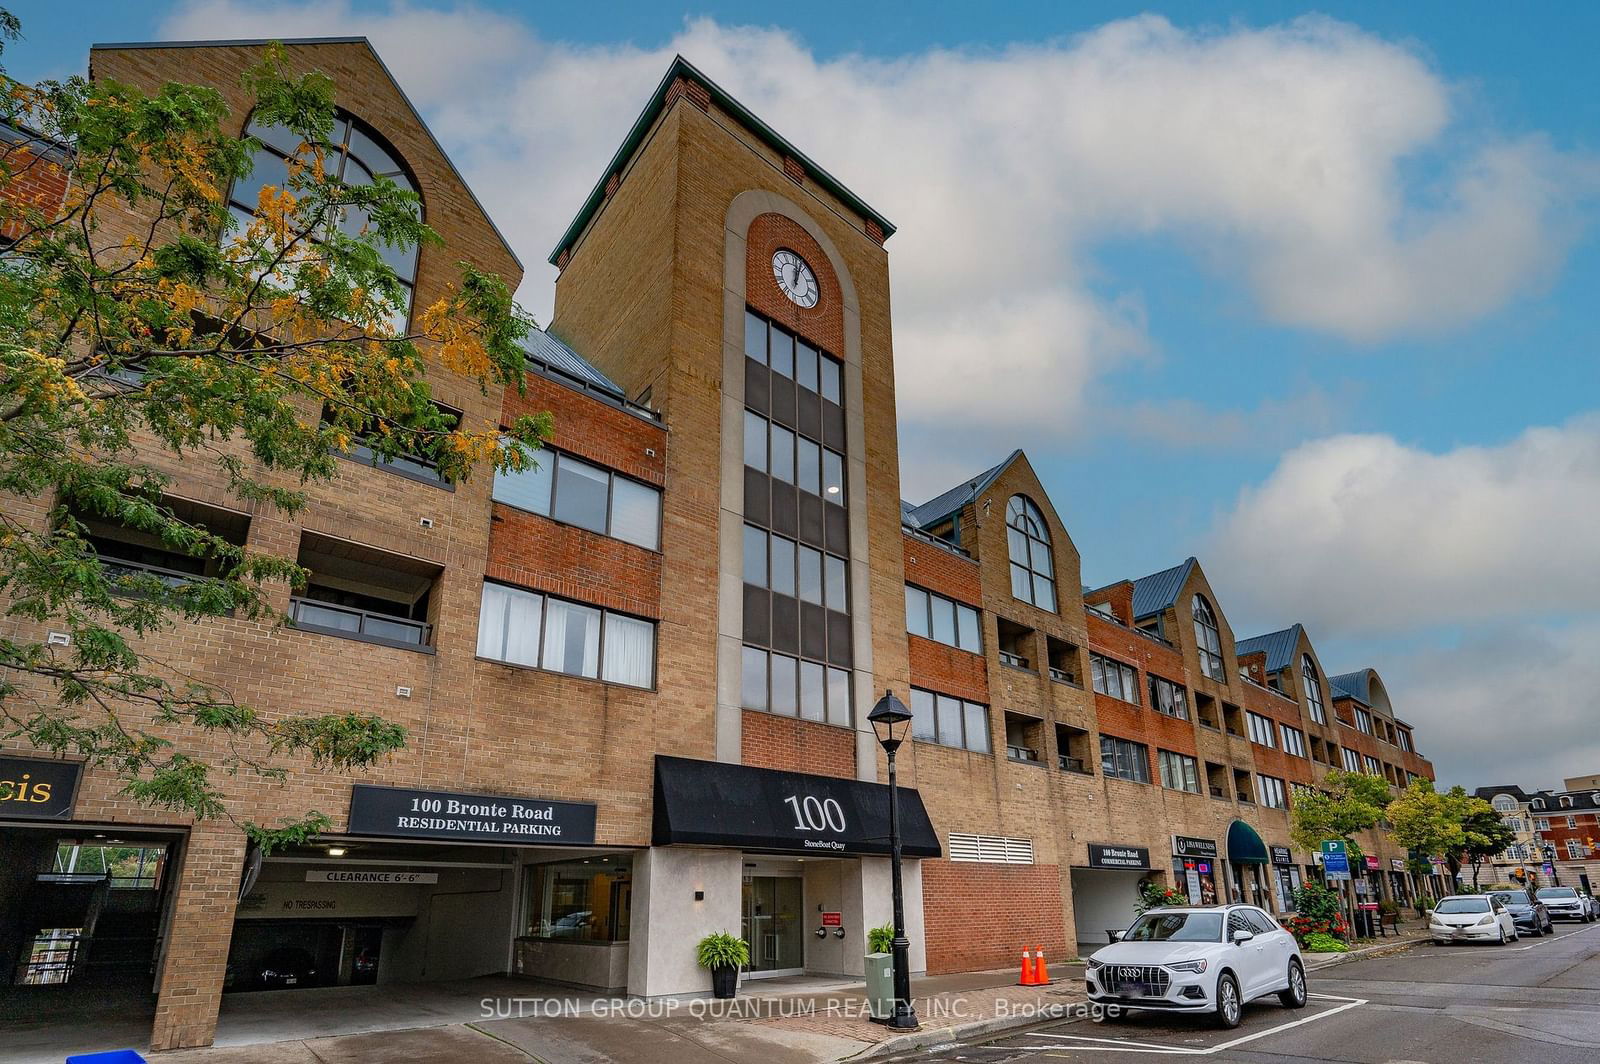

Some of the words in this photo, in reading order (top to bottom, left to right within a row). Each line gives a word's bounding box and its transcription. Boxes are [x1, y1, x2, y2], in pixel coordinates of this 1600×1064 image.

[410, 798, 442, 813] 100
[446, 799, 507, 818] Bronte
[511, 804, 553, 820] Road
[784, 795, 846, 833] 100
[397, 816, 500, 833] RESIDENTIAL
[502, 823, 562, 836] PARKING
[831, 841, 846, 851] Quay
[1328, 842, 1338, 852] P
[1102, 848, 1111, 856] 100
[1111, 849, 1127, 858] Bronte
[1127, 850, 1139, 859] Road
[326, 872, 390, 882] CLEARANCE
[283, 900, 293, 910] NO
[294, 900, 337, 910] TRESPASSING
